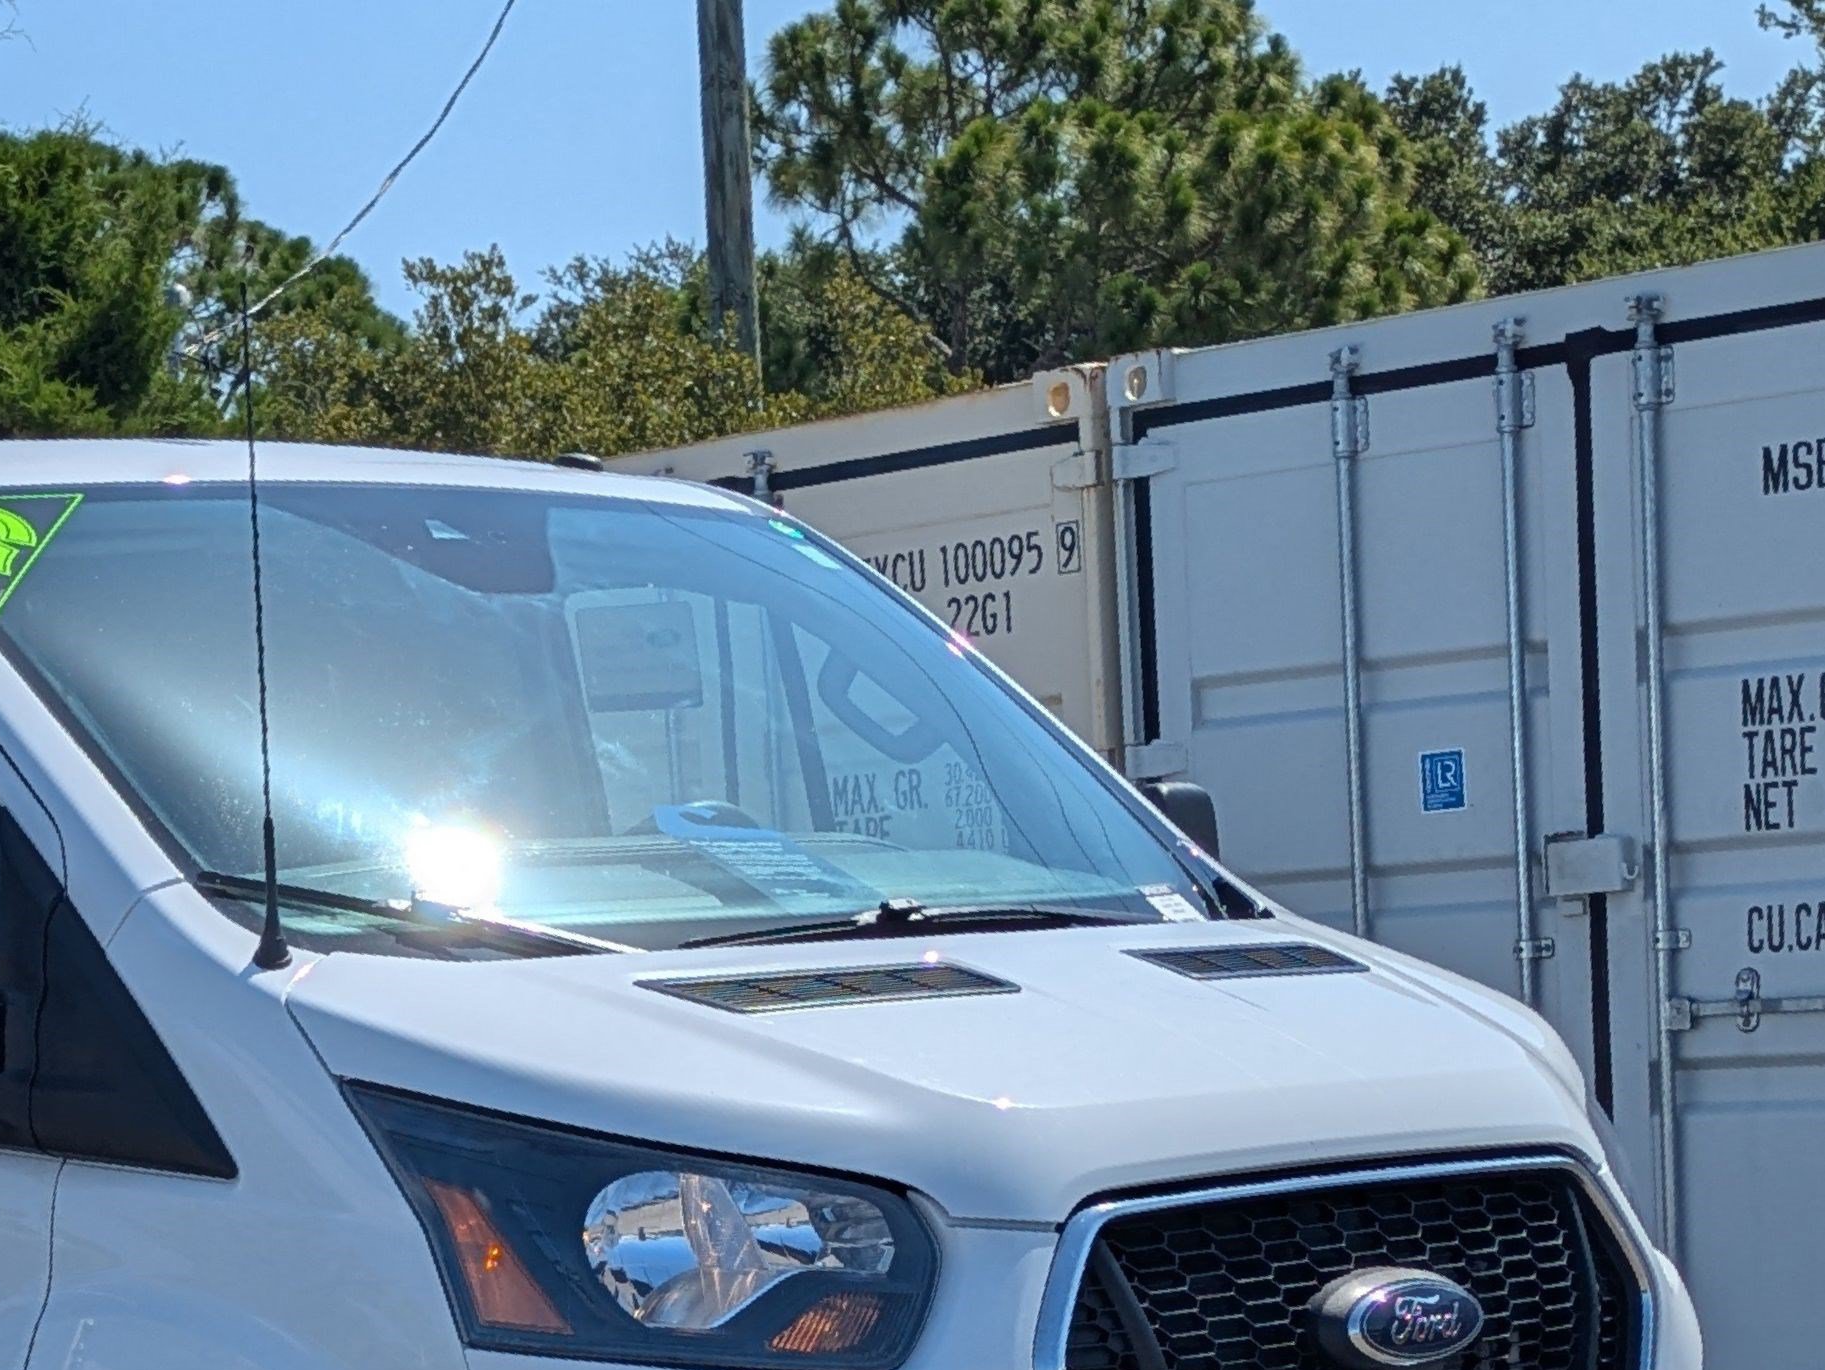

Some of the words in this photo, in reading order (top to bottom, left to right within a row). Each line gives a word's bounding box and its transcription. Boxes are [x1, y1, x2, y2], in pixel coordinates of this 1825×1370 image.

[862, 548, 926, 593] CU
[940, 530, 1043, 588] 100095
[1059, 525, 1077, 570] 9
[946, 590, 1013, 637] 22G1
[1742, 726, 1818, 780] TARE
[832, 772, 885, 818] MAX.
[894, 768, 929, 810] GR.
[1744, 780, 1799, 832] NET
[1390, 1294, 1462, 1345] Ford
